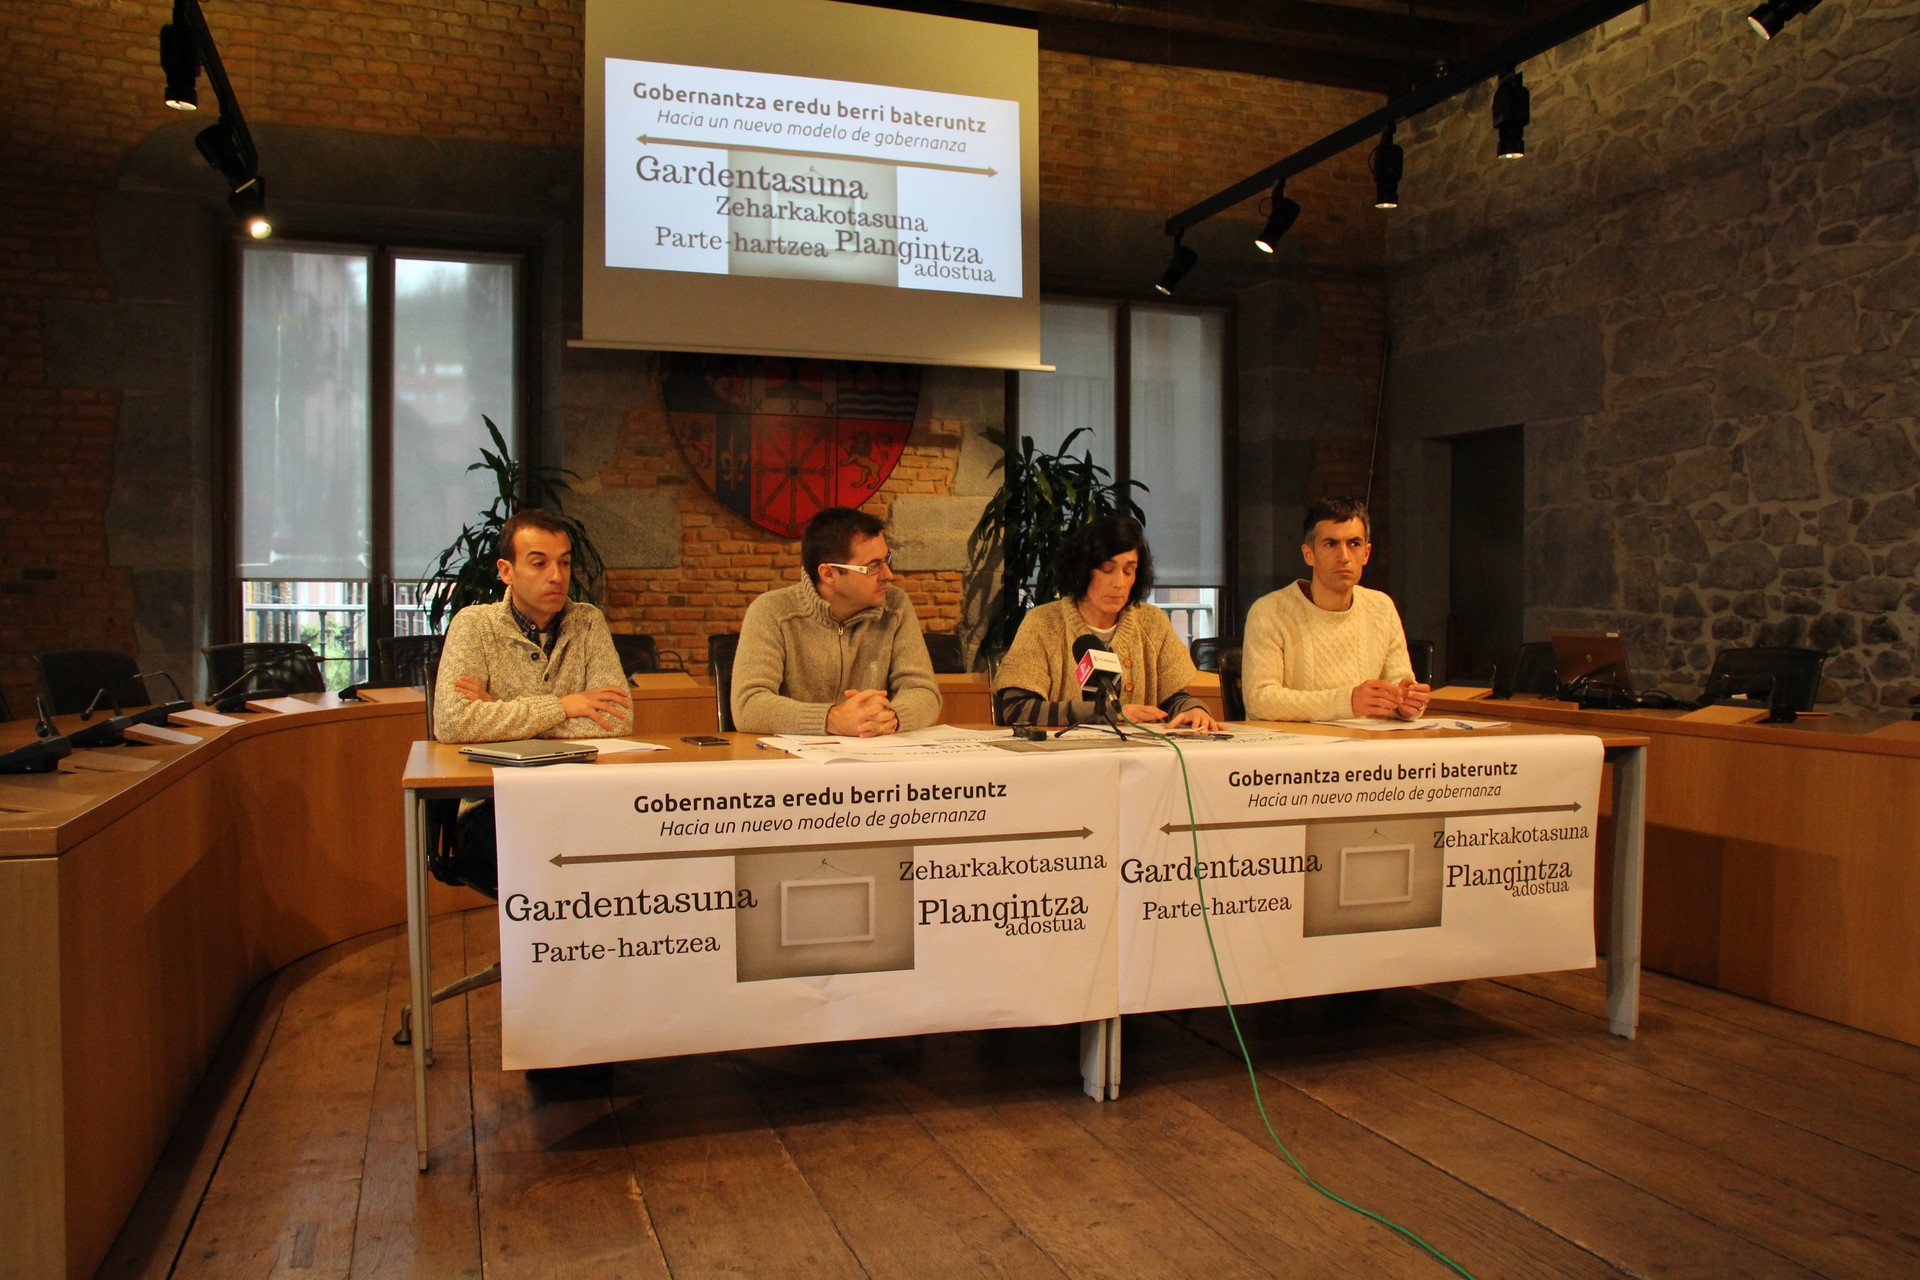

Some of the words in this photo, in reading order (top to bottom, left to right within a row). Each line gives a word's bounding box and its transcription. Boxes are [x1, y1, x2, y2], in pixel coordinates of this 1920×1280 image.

[632, 81, 767, 111] Gobernantza
[772, 96, 831, 117] eredu
[837, 100, 885, 123] berri
[890, 105, 987, 134] bateruntz
[656, 108, 704, 127] Hacia
[709, 116, 728, 129] un
[733, 117, 782, 134] nuevo
[787, 118, 847, 140] modelo
[851, 124, 871, 142] de
[874, 126, 967, 153] gobernanza
[635, 155, 869, 200] Gardentasuna
[715, 195, 928, 233] Zeharkakotasuna
[654, 225, 829, 258] Parte-hartzea
[835, 230, 984, 265] Plangintza
[913, 261, 996, 282] adostua
[1228, 769, 1341, 787] Gobernantza
[1344, 765, 1393, 784] eredu
[1398, 763, 1437, 781] berri
[1440, 761, 1518, 779] bateruntz
[633, 791, 777, 814] Gobernantza
[782, 786, 844, 808] eredu
[850, 784, 901, 805] berri
[906, 780, 1008, 802] bateruntz
[1247, 792, 1287, 808] Hacia
[1290, 794, 1308, 806] un
[1311, 791, 1352, 805] nuevo
[1355, 786, 1405, 803] modelo
[1408, 786, 1424, 801] de
[1427, 784, 1501, 803] gobernanza
[659, 817, 709, 837] Hacia
[714, 820, 736, 834] un
[740, 816, 792, 834] nuevo
[798, 810, 860, 830] modelo
[864, 810, 885, 828] de
[888, 807, 987, 831] gobernanza
[1433, 824, 1589, 849] Zeharkakotasuna
[899, 851, 1108, 882] Zeharkakotasuna
[1120, 851, 1322, 884] Gardentasuna
[1446, 859, 1573, 890] Plangintza
[504, 885, 758, 922] Gardentasuna
[1512, 878, 1570, 897] adostua
[918, 892, 1089, 929] Plangintza
[1004, 912, 1086, 937] adostua
[532, 934, 720, 964] Parte-hartzea
